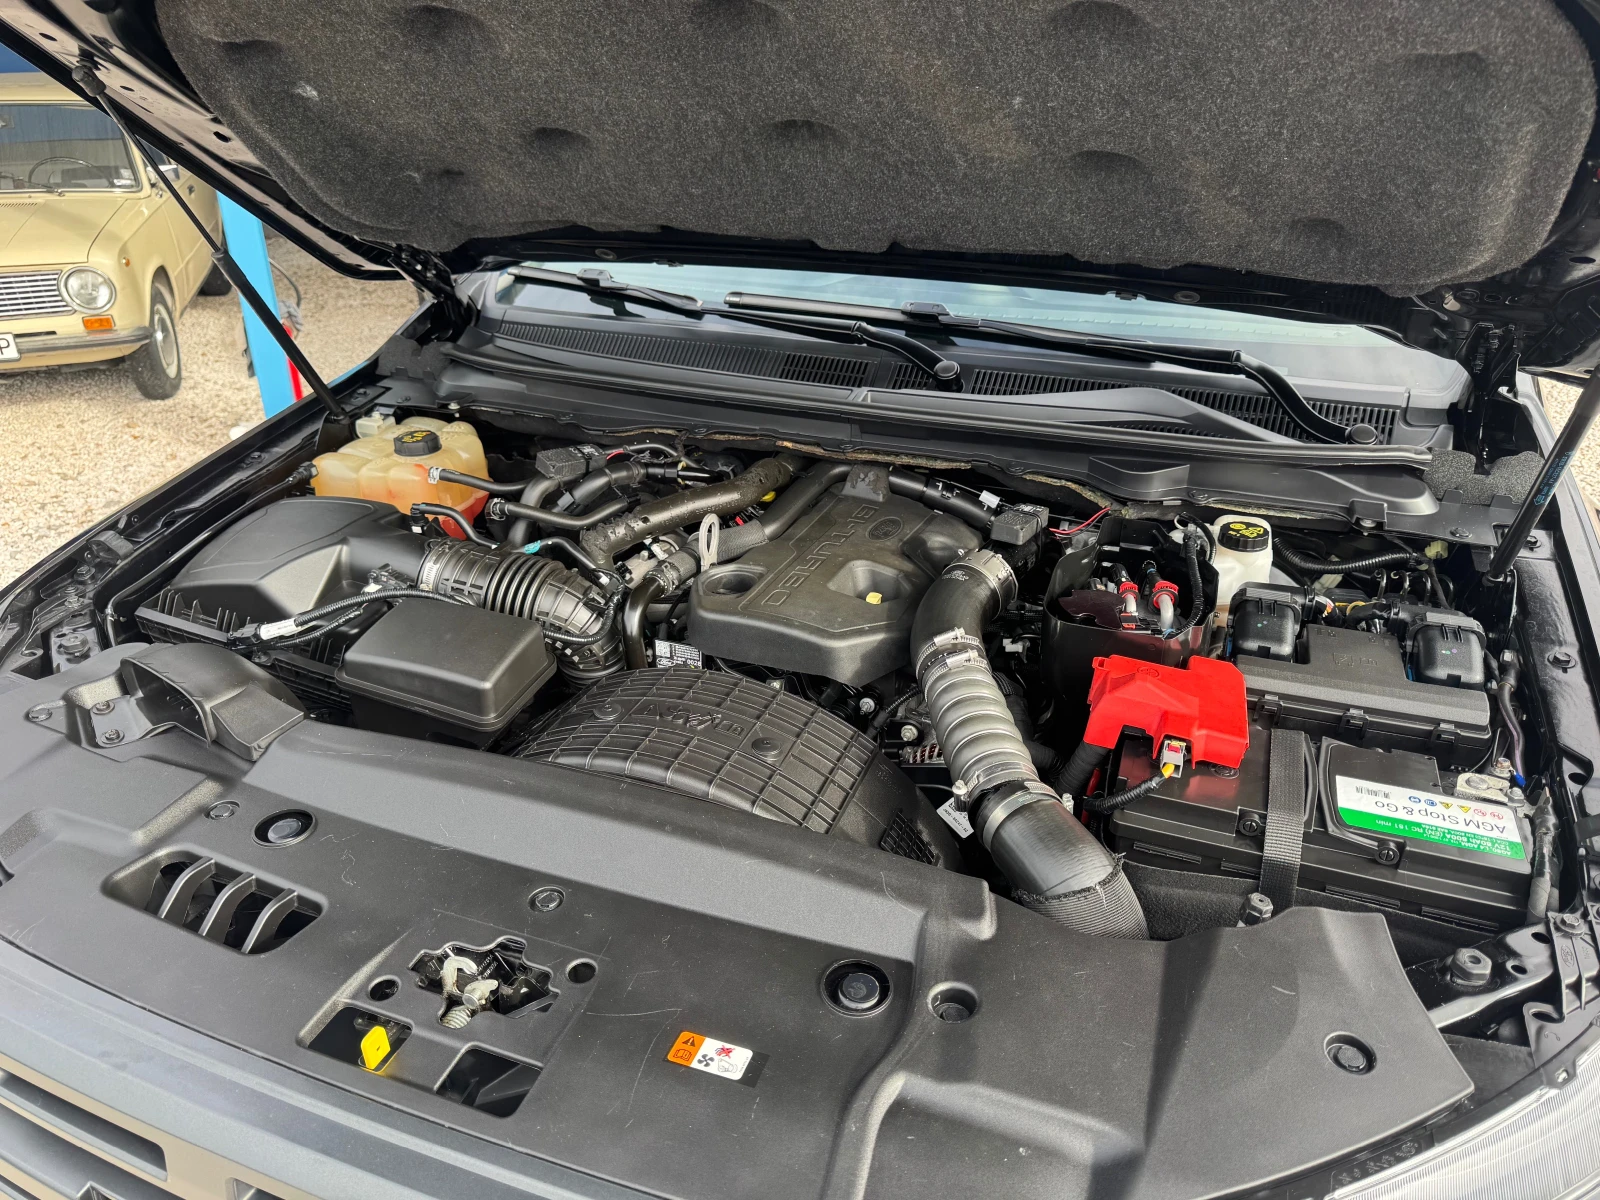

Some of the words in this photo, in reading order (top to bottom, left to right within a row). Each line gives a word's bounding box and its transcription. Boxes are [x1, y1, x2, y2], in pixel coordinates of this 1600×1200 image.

[761, 504, 879, 605] BI-TURBO
[1374, 800, 1399, 813] Go
[1401, 806, 1414, 816] &
[1417, 807, 1460, 825] Stop
[1463, 817, 1506, 834] AGM
